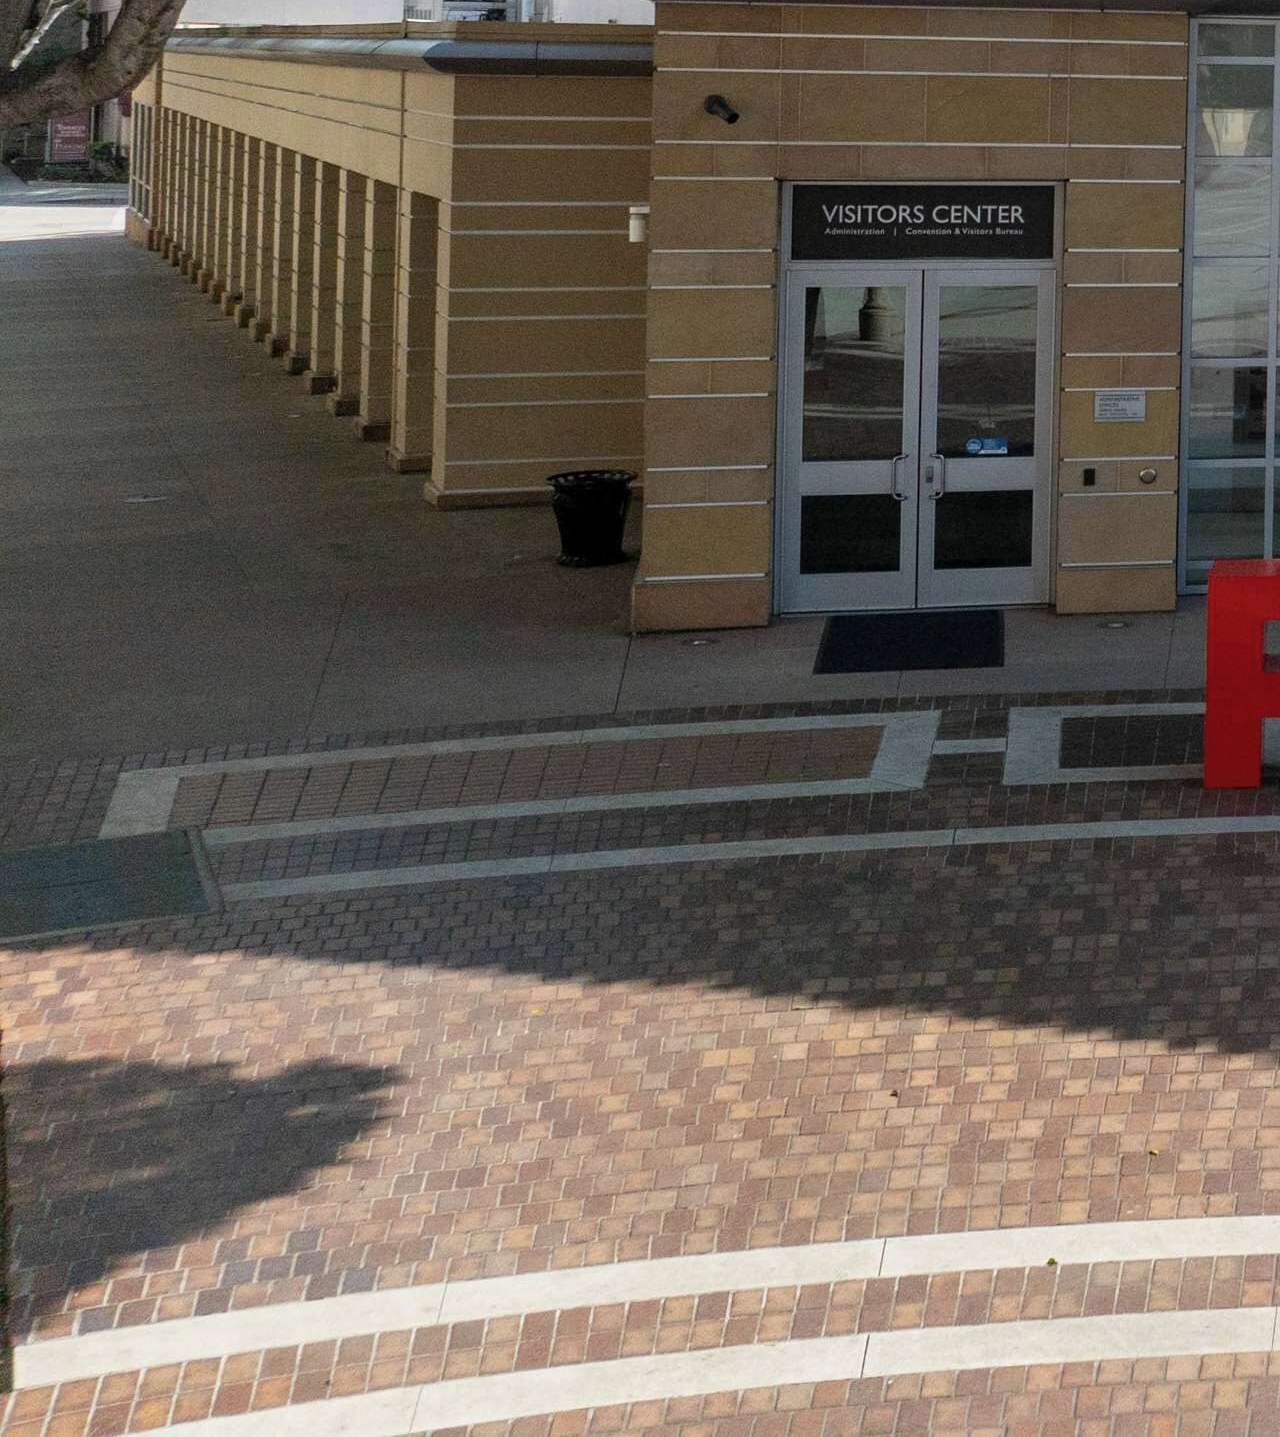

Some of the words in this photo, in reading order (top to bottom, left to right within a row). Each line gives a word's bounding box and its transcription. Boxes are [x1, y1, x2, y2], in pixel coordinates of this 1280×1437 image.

[821, 204, 925, 224] VISITORS
[932, 204, 1025, 224] CENTER
[824, 227, 885, 236] Administration
[905, 227, 952, 236] Convention
[962, 227, 994, 236] Visitors
[995, 227, 1024, 236] Bureau
